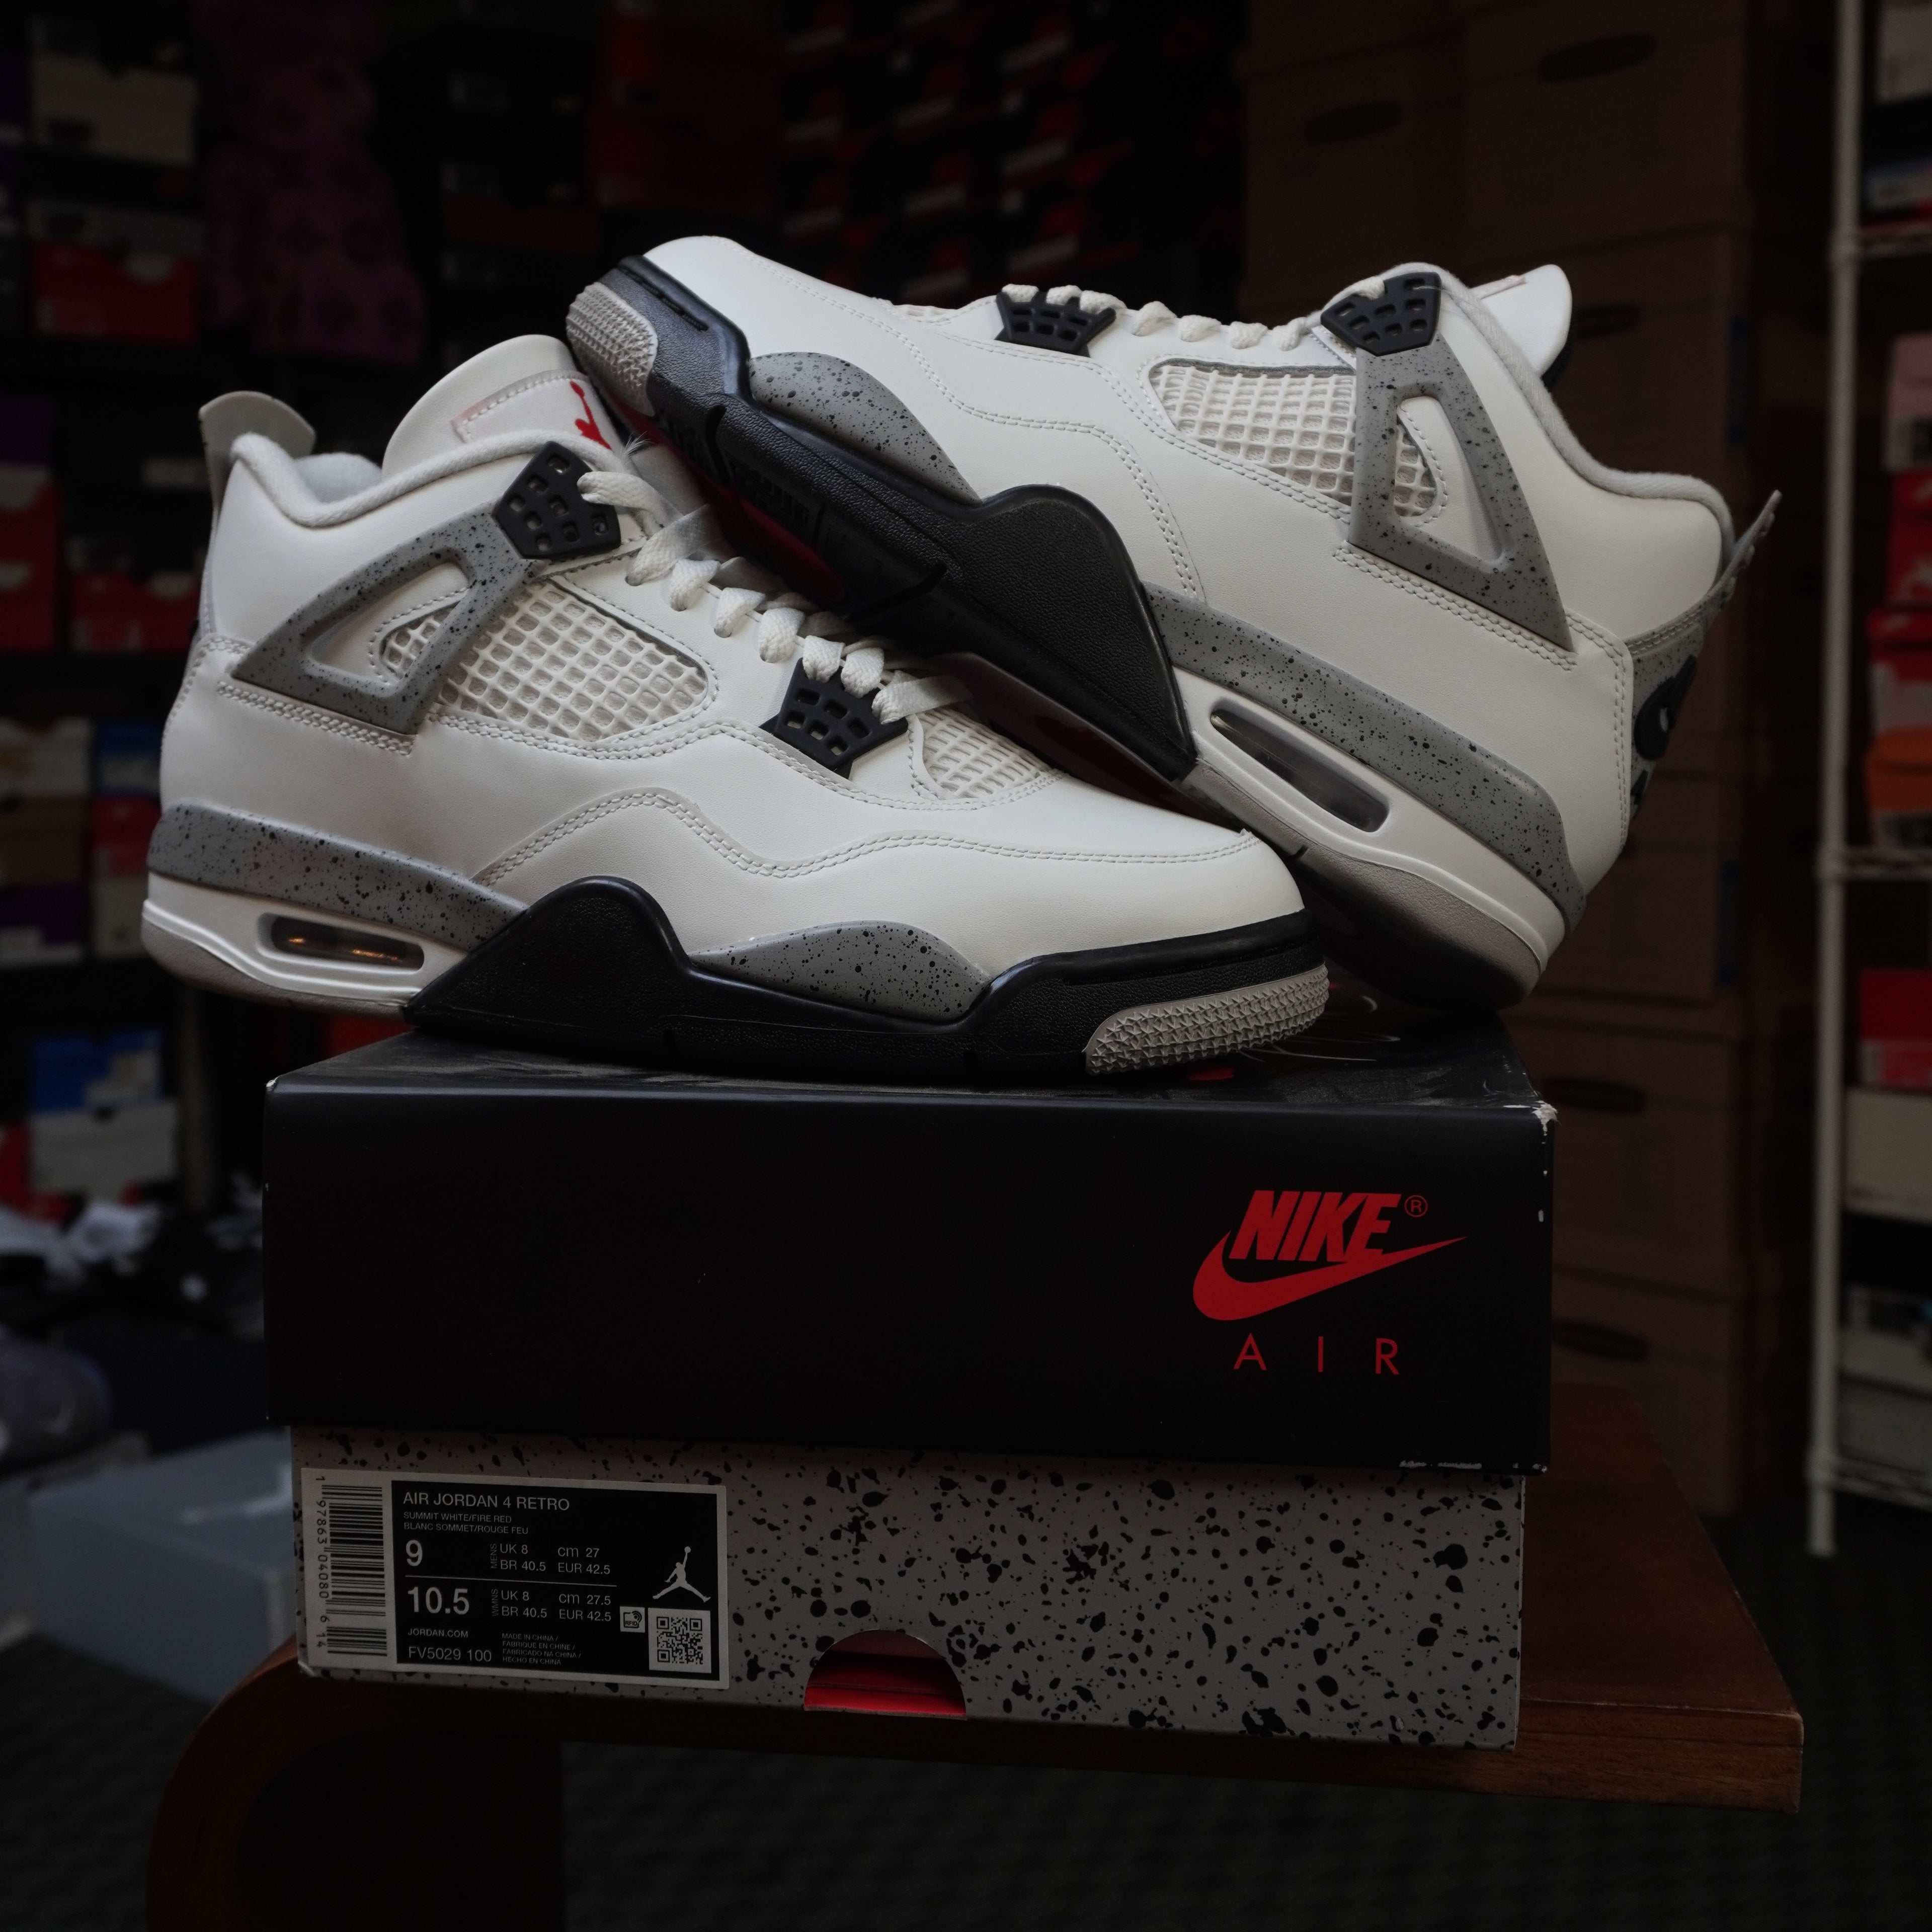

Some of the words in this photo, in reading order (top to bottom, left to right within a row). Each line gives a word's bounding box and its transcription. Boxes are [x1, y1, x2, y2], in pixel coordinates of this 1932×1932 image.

[1229, 1190, 1402, 1262] NIKE
[1233, 1332, 1400, 1376] AIR
[403, 1492, 429, 1505] AIR
[434, 1493, 498, 1508] JORDAN
[503, 1496, 511, 1508] 4
[516, 1496, 570, 1510] RETRO
[316, 1500, 327, 1544] 97863
[404, 1512, 439, 1520] SUMMIT
[441, 1513, 491, 1522] WHITE/FIRE
[436, 1524, 509, 1534] SOMMET/ROUGE
[511, 1526, 529, 1535] FEU
[406, 1539, 423, 1567] 9
[500, 1543, 517, 1554] UK
[521, 1544, 529, 1555] 8
[557, 1547, 579, 1558] cm
[586, 1547, 600, 1558] 27
[490, 1543, 498, 1569] MENS
[500, 1560, 517, 1570] BR
[521, 1561, 546, 1572] 40.5
[557, 1562, 582, 1573] EUR
[586, 1564, 611, 1575] 42.5
[318, 1555, 329, 1598] 04080
[407, 1586, 470, 1615] 10.5
[501, 1590, 518, 1601] UK
[522, 1591, 529, 1601] 8
[558, 1593, 580, 1604] cm
[586, 1594, 611, 1605] 27.5
[491, 1588, 499, 1617] WMNS
[501, 1606, 518, 1617] BR
[522, 1607, 547, 1618] 40.5
[559, 1609, 583, 1620] EUR
[587, 1611, 611, 1622] 42.5
[407, 1628, 468, 1638] JORDAN.COM
[502, 1640, 537, 1649] FABRIQUE
[408, 1646, 461, 1661] FV5029
[467, 1649, 492, 1662] 100
[503, 1648, 542, 1657] FABRICADO
